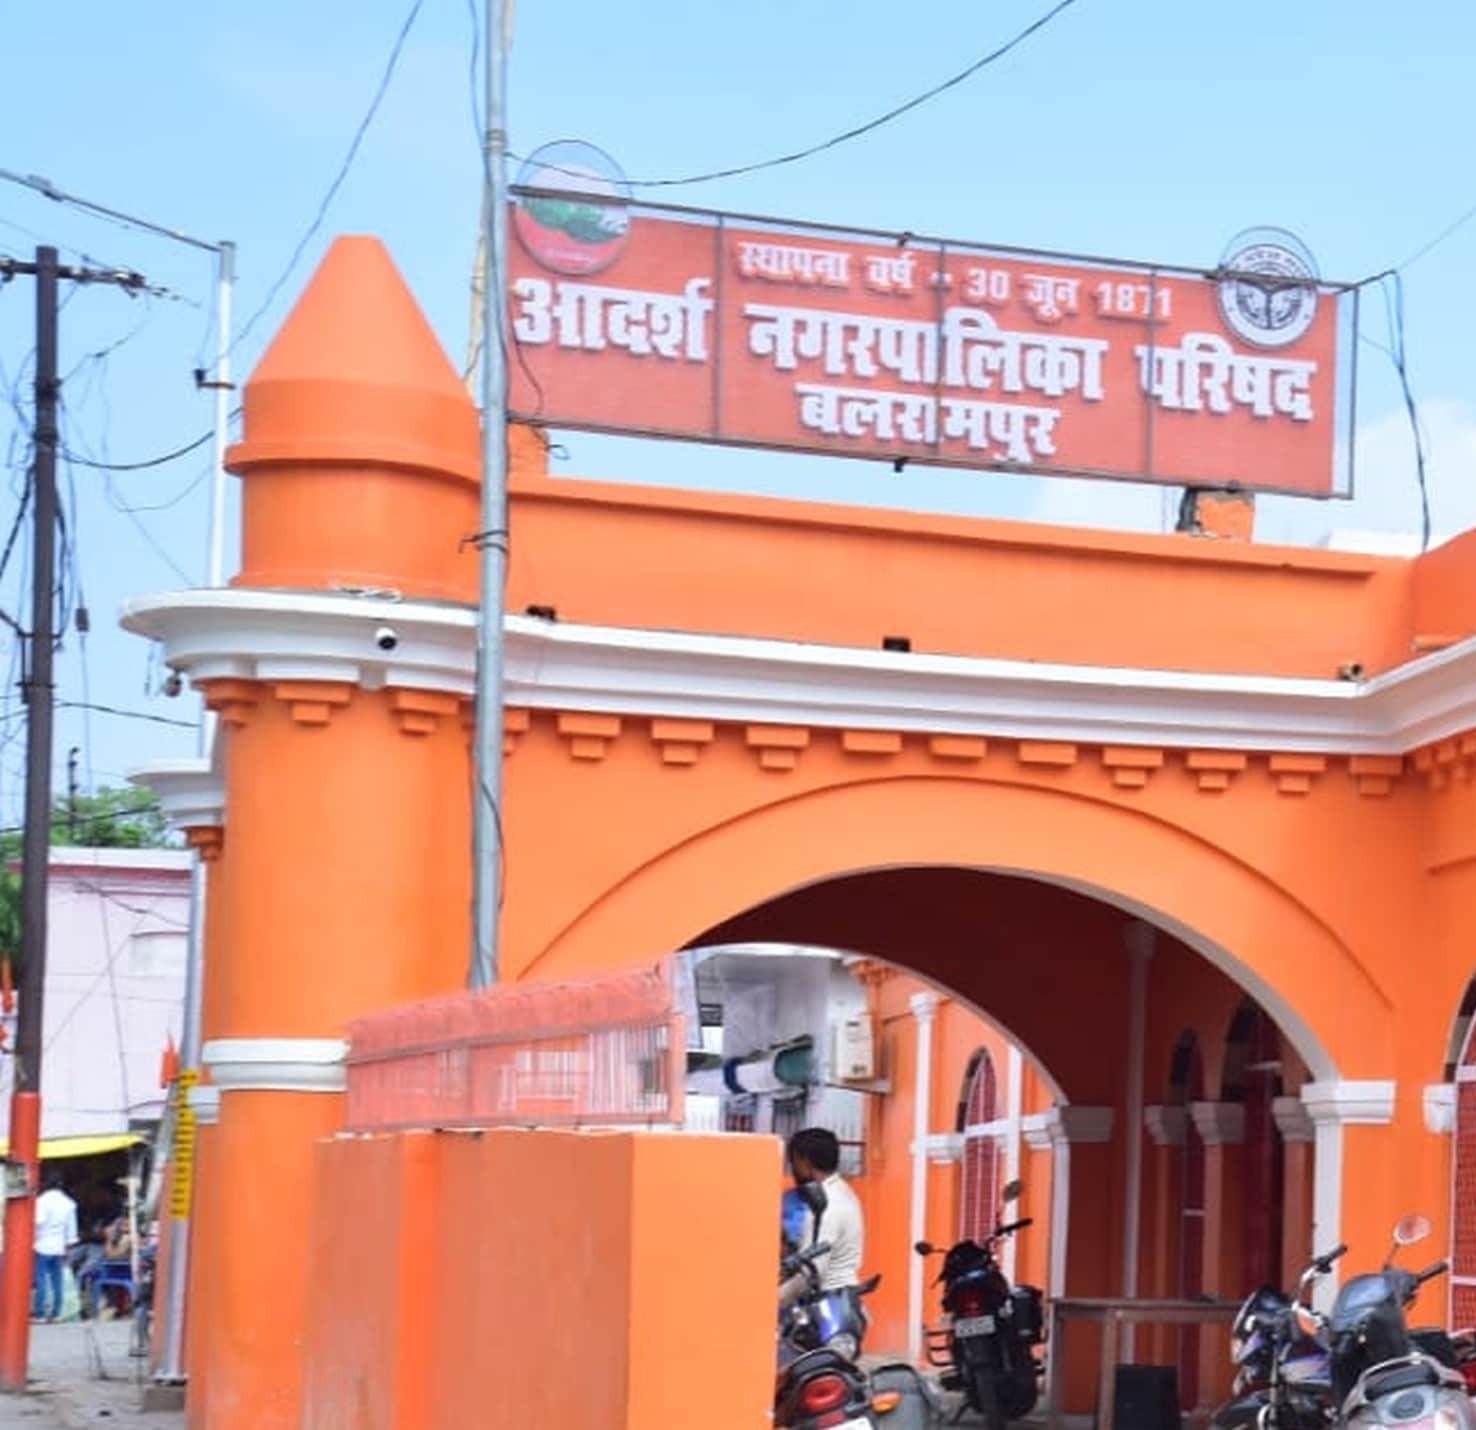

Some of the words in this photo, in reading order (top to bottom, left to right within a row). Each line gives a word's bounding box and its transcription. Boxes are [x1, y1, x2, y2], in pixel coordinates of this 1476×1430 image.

[866, 250, 915, 288] वर्ष
[967, 268, 1010, 300] 30
[1023, 273, 1080, 317] जून
[1097, 281, 1171, 317] 1871
[512, 277, 713, 360] आदर्श
[744, 304, 1109, 400] नगरपालिका
[1134, 331, 1318, 422] परिषद
[795, 382, 1061, 463] बलरामपुर
